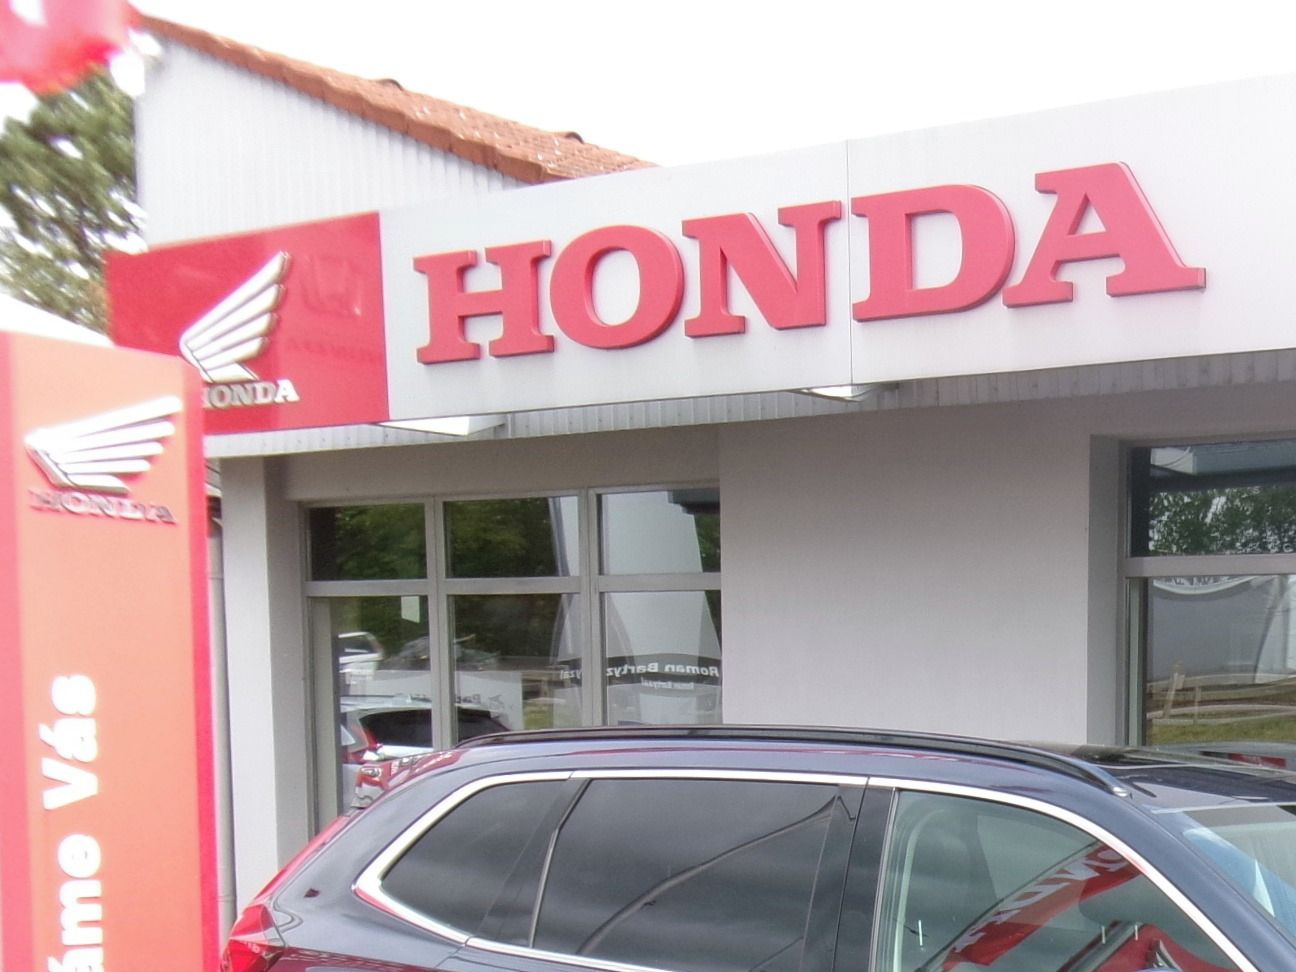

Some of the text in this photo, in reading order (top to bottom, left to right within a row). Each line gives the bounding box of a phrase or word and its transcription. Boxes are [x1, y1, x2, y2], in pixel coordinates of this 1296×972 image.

[412, 161, 1207, 365] HONDA
[28, 488, 177, 525] HONDA
[39, 674, 98, 811] Vás
